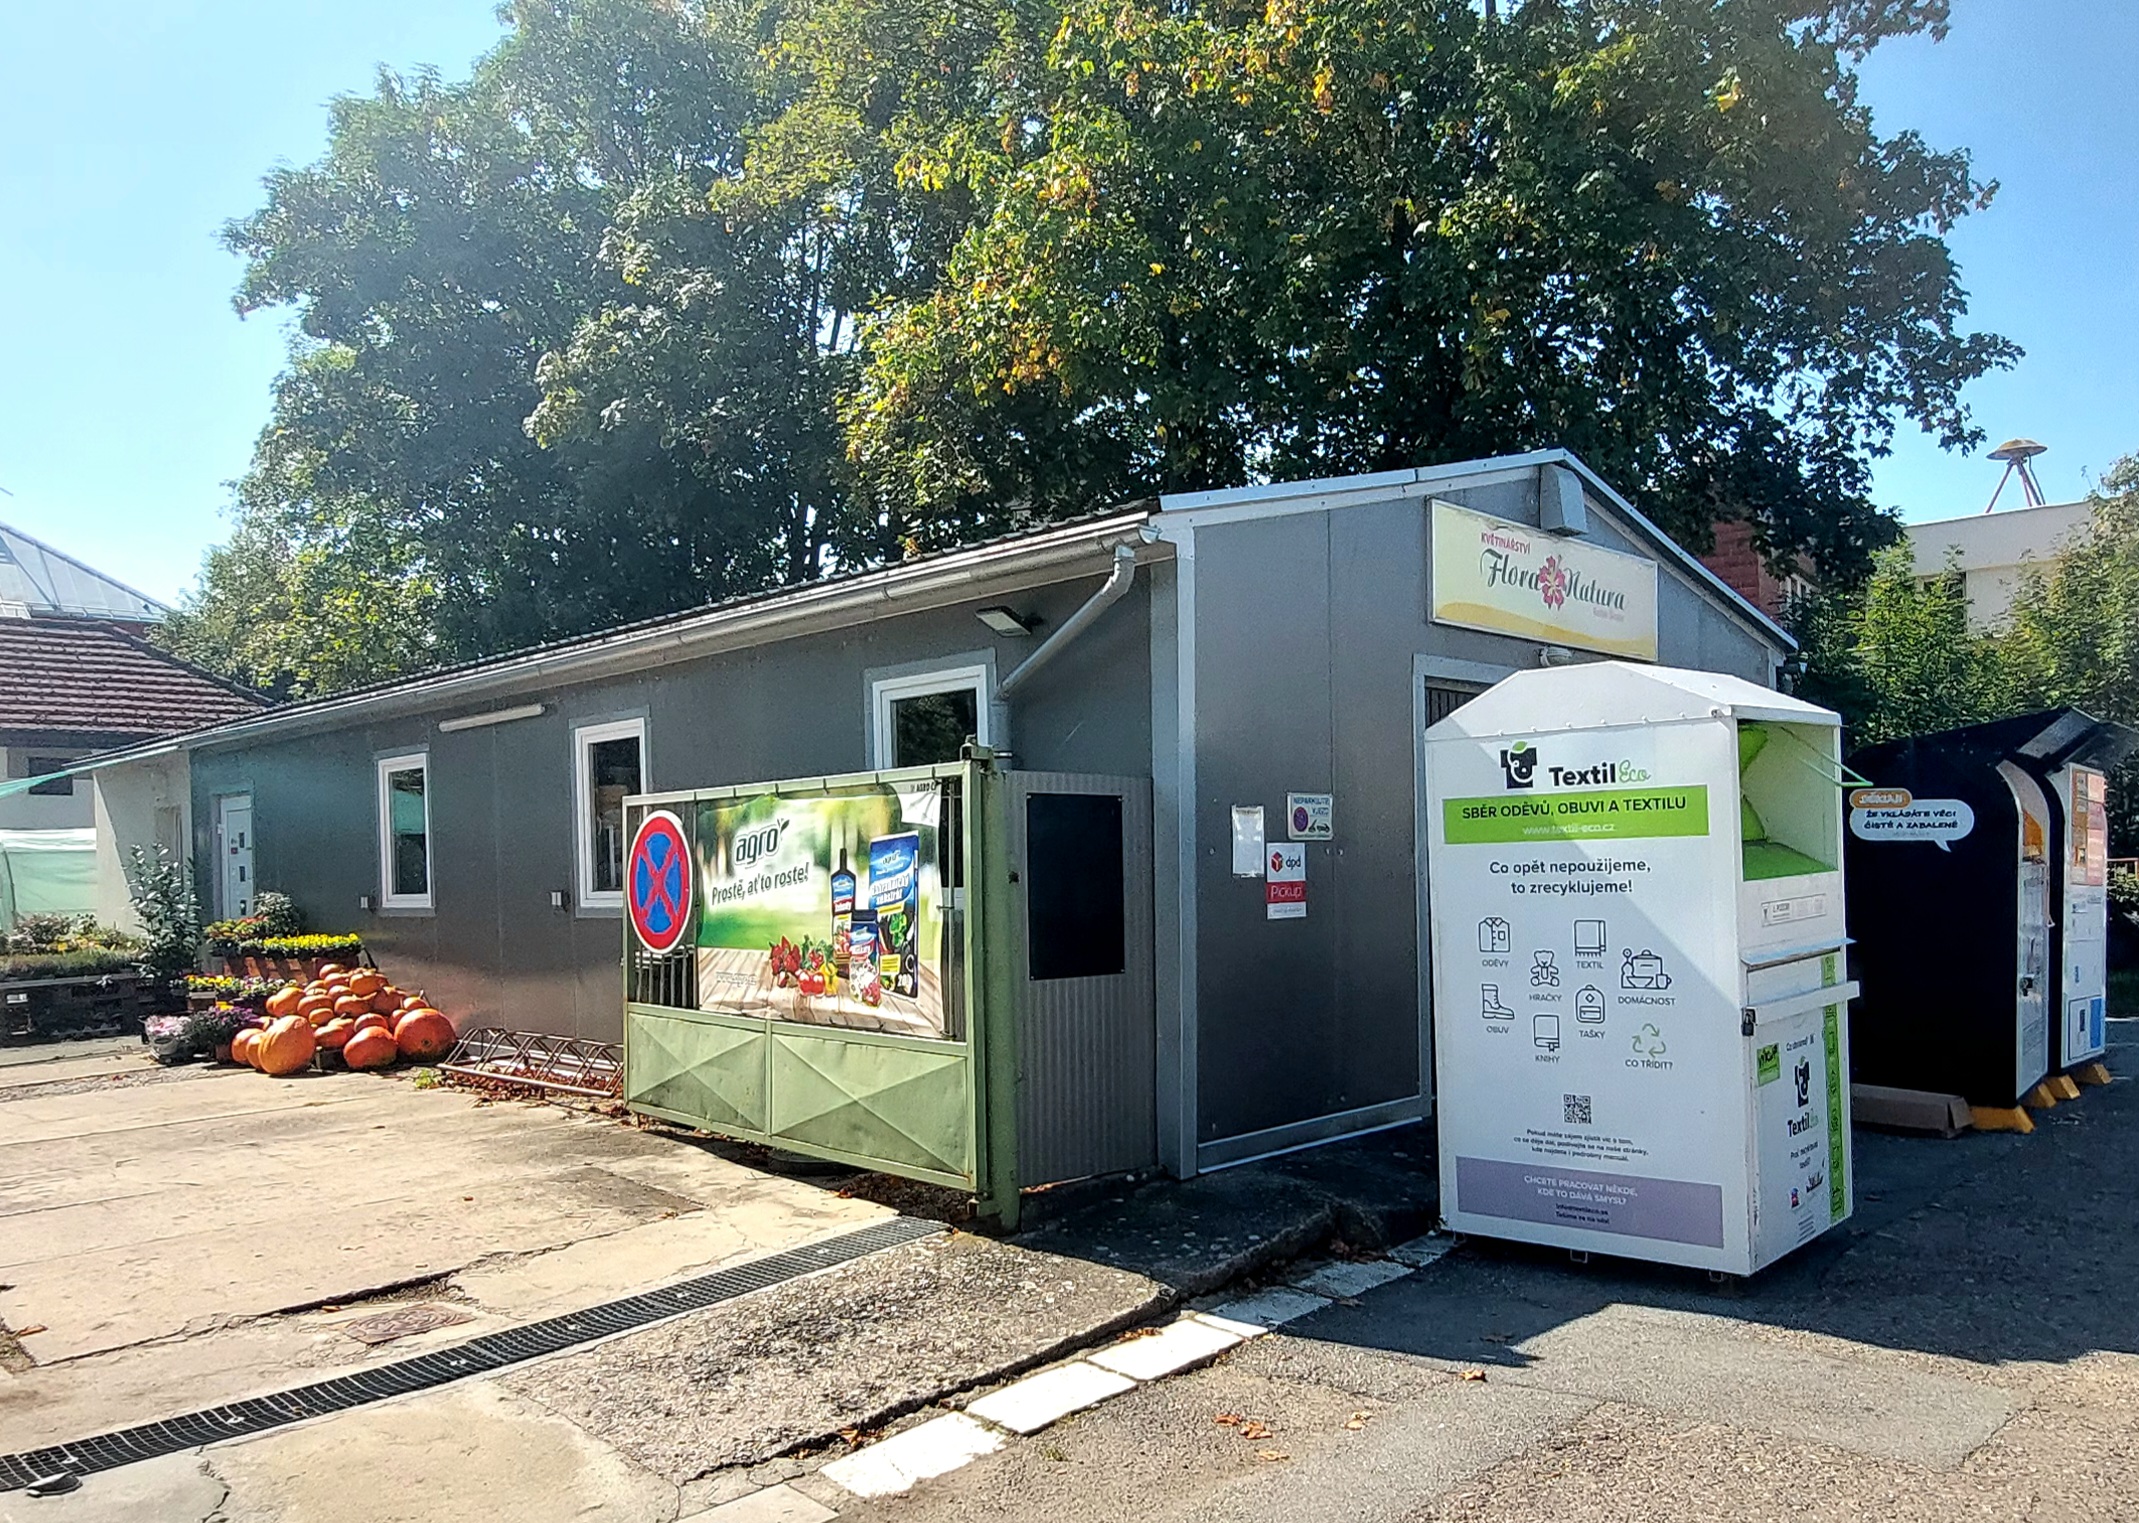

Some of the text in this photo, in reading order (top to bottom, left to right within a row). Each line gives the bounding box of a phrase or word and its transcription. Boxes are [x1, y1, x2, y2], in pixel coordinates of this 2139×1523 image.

[1480, 548, 1625, 610] Flora Natura
[1548, 760, 1652, 787] Textil Eco
[1462, 796, 1686, 818] SBĚR ODĚVŮ, OBUVI A TEXTILU
[736, 828, 778, 865] agro
[1286, 856, 1301, 870] dpd
[1490, 858, 1652, 877] Co opět nepoužijeme,
[712, 879, 746, 906] Prostě,
[760, 874, 772, 892] to
[774, 862, 810, 889] roste!
[1511, 879, 1633, 896] to zrecyklujeme!
[1270, 885, 1302, 899] Pickup
[1482, 958, 1510, 968] ODĚVY
[1576, 960, 1604, 970] TEXTIL
[1529, 993, 1562, 1002] HRAČKY
[1618, 995, 1676, 1006] DOMÁCNOST
[1486, 1025, 1510, 1034] OBUV
[1578, 1029, 1606, 1039] TAŠKY
[1534, 1054, 1560, 1064] KNIHY
[1625, 1058, 1673, 1070] CO TŘÍDIT?
[1788, 1113, 1810, 1138] Textil
[1524, 1175, 1556, 1186] CHCETE
[1559, 1180, 1603, 1191] PRACOVAT
[1538, 1188, 1554, 1196] KDE
[1570, 1191, 1592, 1200] DÁVÁ
